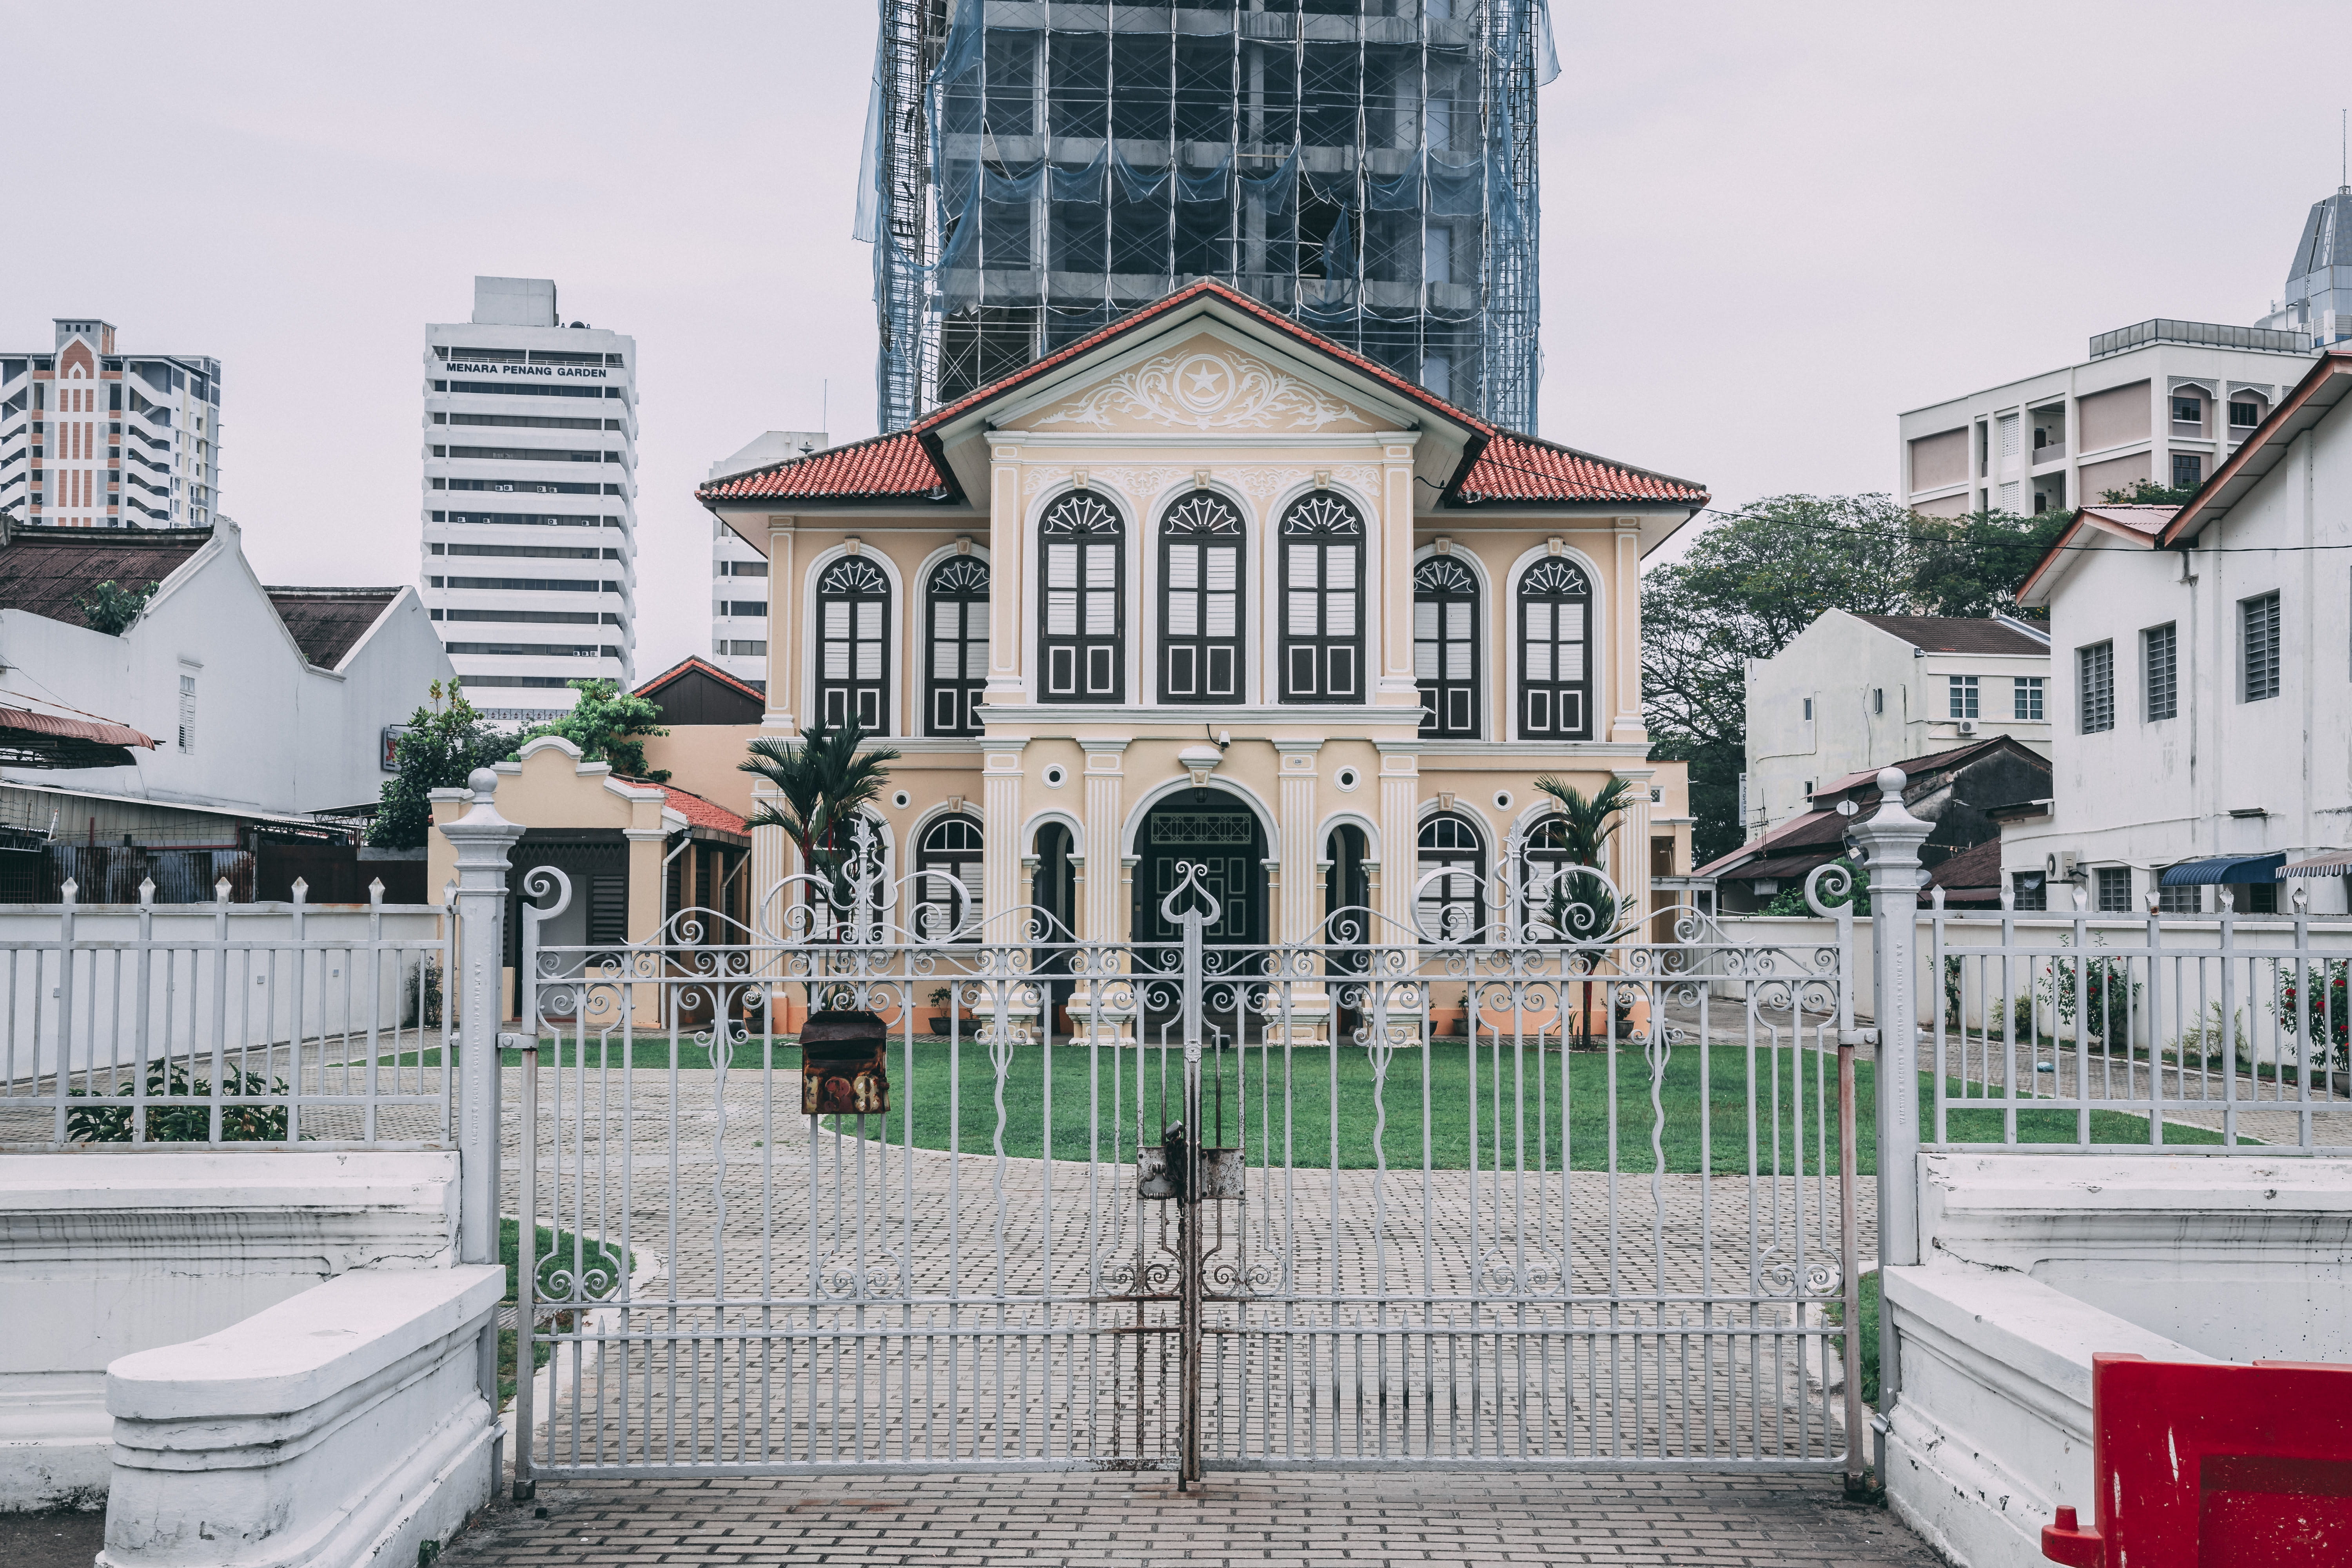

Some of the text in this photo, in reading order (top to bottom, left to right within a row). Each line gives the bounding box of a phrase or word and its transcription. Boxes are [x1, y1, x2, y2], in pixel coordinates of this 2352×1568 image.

[446, 363, 607, 378] MENARA PENANG GARDEN
[804, 1074, 880, 1112] 138
